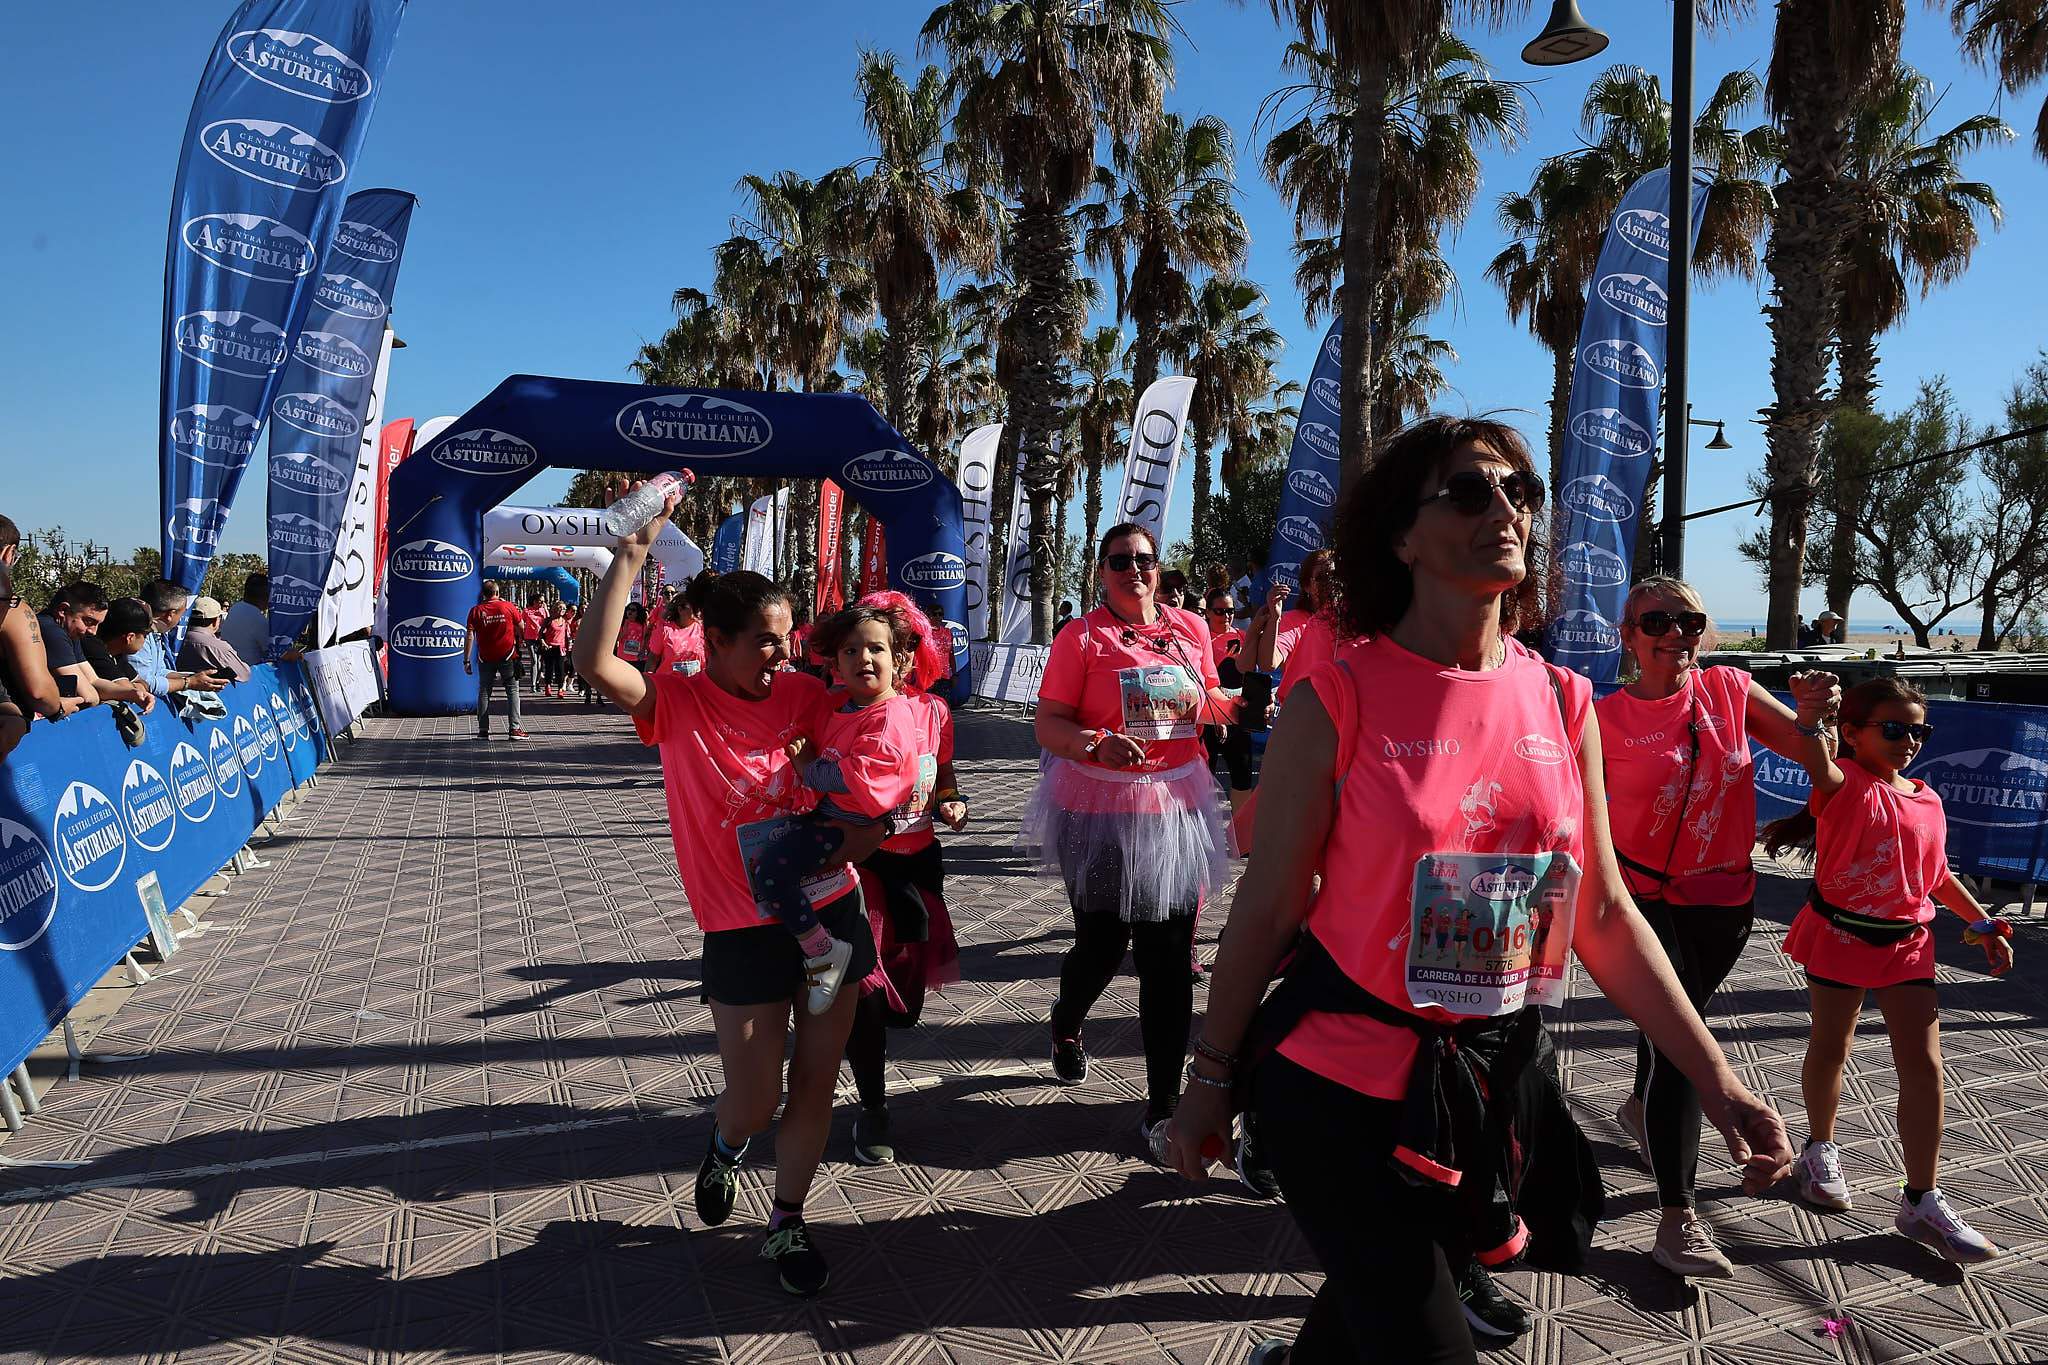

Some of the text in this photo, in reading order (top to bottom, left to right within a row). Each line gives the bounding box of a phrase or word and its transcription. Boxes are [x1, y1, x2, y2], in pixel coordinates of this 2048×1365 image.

[264, 42, 310, 62] CENTRAL
[236, 40, 359, 95] ASTURIANA
[240, 132, 288, 153] CENTRAL
[220, 227, 268, 246] CENTRAL
[1603, 281, 1666, 322] ASTURIANA
[278, 399, 352, 433] ASTURIANA
[628, 409, 762, 443] ASTURIANA
[653, 410, 757, 422] CENTRAL LECHERA
[1576, 418, 1642, 452] ASTURIANA
[437, 445, 530, 465] ASTURIANA
[493, 444, 529, 452] LECHERA
[270, 461, 341, 491] ASTURIANA
[850, 465, 929, 480] ASTURIANA
[826, 490, 838, 557] Santander
[395, 554, 468, 573] ASTURIANA
[1384, 738, 1460, 758] OYSHO
[1942, 771, 1997, 783] CENTRAL
[175, 773, 214, 809] ASTURIANA
[67, 808, 113, 837] CENTRAL LECHERA
[127, 795, 174, 837] ASTURIANA
[61, 821, 124, 876] ASTURIANA
[1428, 869, 1458, 878] SUMA
[1472, 924, 1526, 953] 016
[1485, 959, 1513, 971] 5776
[1416, 969, 1461, 983] CARRERA
[1464, 974, 1478, 984] DE
[1480, 974, 1492, 984] LA
[1495, 973, 1519, 985] MUJER
